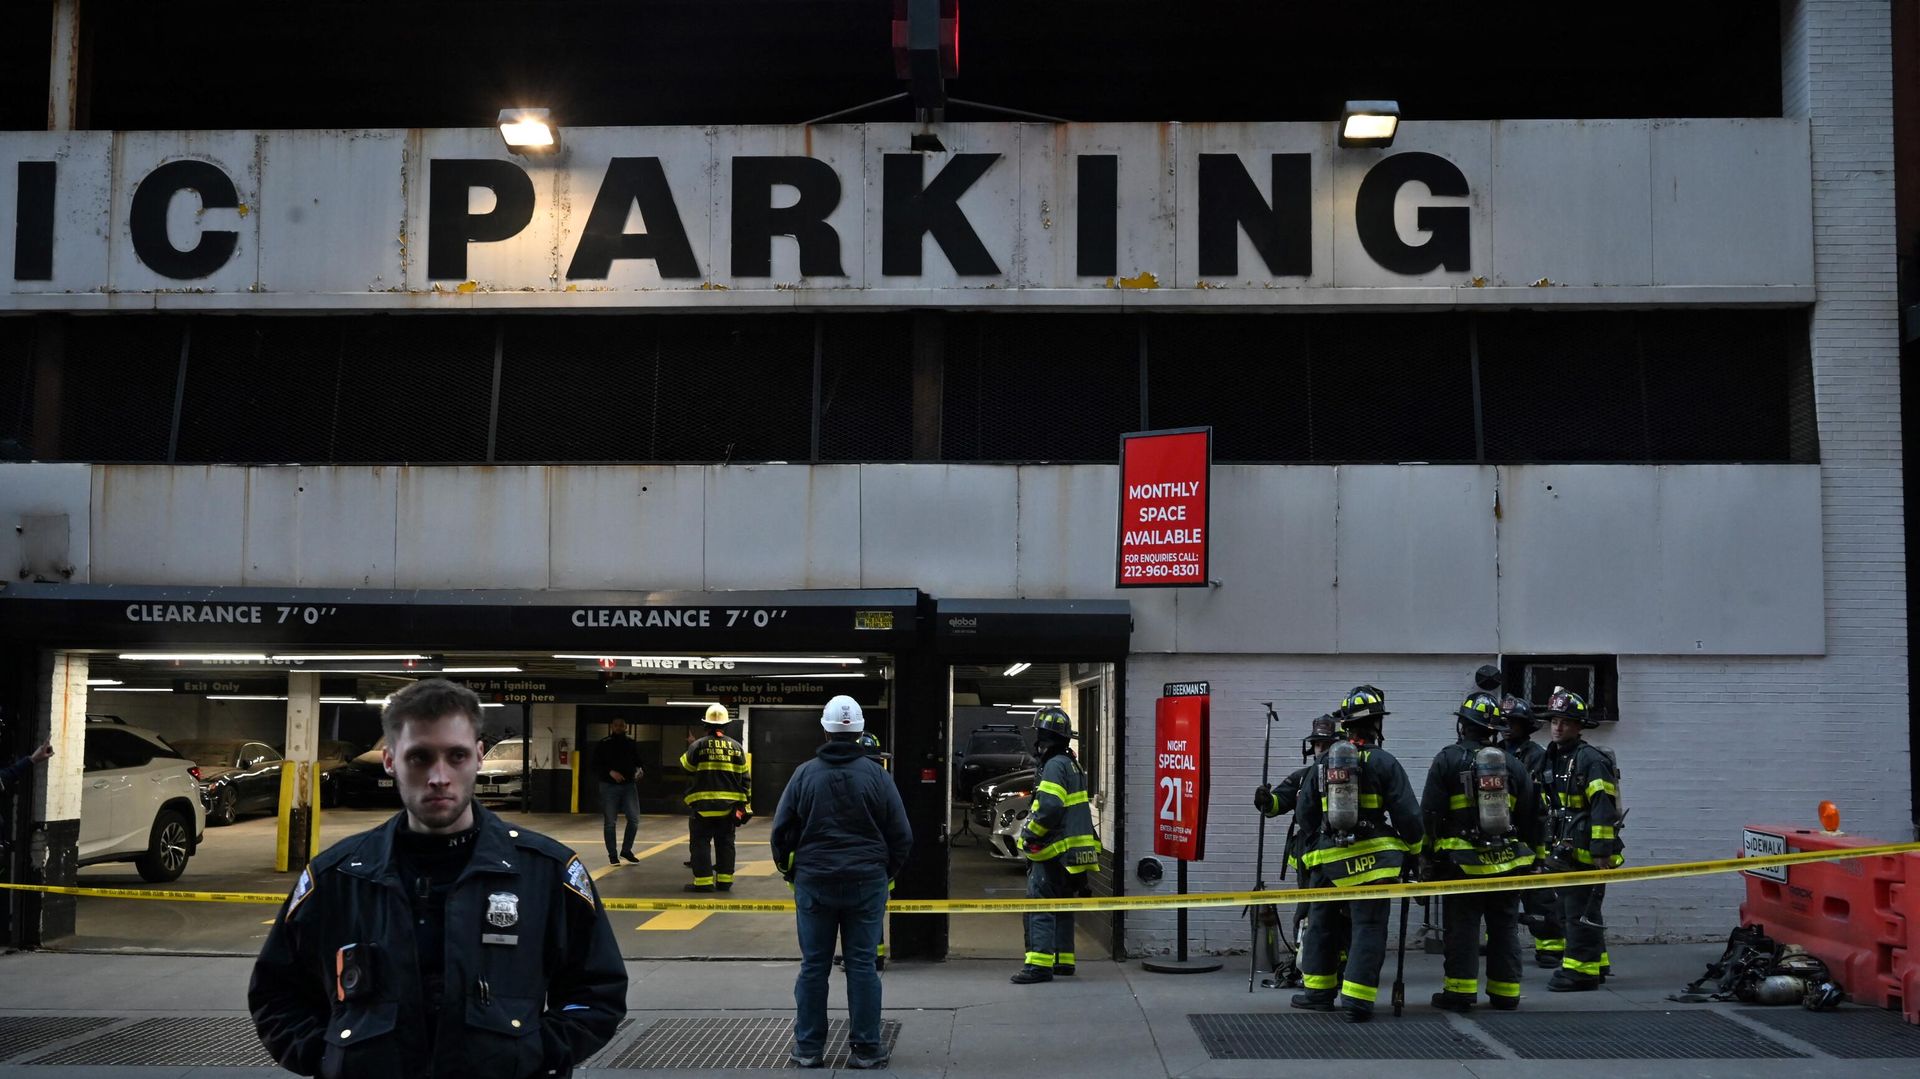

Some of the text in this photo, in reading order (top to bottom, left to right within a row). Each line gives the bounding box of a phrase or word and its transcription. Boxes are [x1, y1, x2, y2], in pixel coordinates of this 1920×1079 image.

[14, 151, 1471, 281] IC PARKING
[1129, 481, 1199, 499] MONTHLY
[1139, 506, 1186, 522] SPACE
[1123, 528, 1201, 546] AVAILABLE
[1125, 552, 1199, 564] FOR ENQUIRIES CALL:
[1124, 564, 1199, 577] 212-960-8301
[126, 604, 262, 624] CLEARANCE
[571, 609, 710, 627] CLEARANCE
[948, 617, 977, 627] global
[184, 681, 240, 693] Exit Only
[466, 680, 547, 691] key in ignition
[705, 682, 824, 694] Leave key in ignition
[1165, 684, 1172, 696] 27
[1172, 683, 1199, 696] BEEKMAN
[504, 692, 555, 703] stop here
[732, 694, 783, 704] stop here
[1167, 740, 1187, 752] NIGHT
[1158, 754, 1195, 771] SPECIAL
[1480, 777, 1501, 787] L-16
[1160, 776, 1193, 822] 21 12
[1746, 837, 1782, 855] SIDEWALK
[1346, 855, 1376, 875] LAPP
